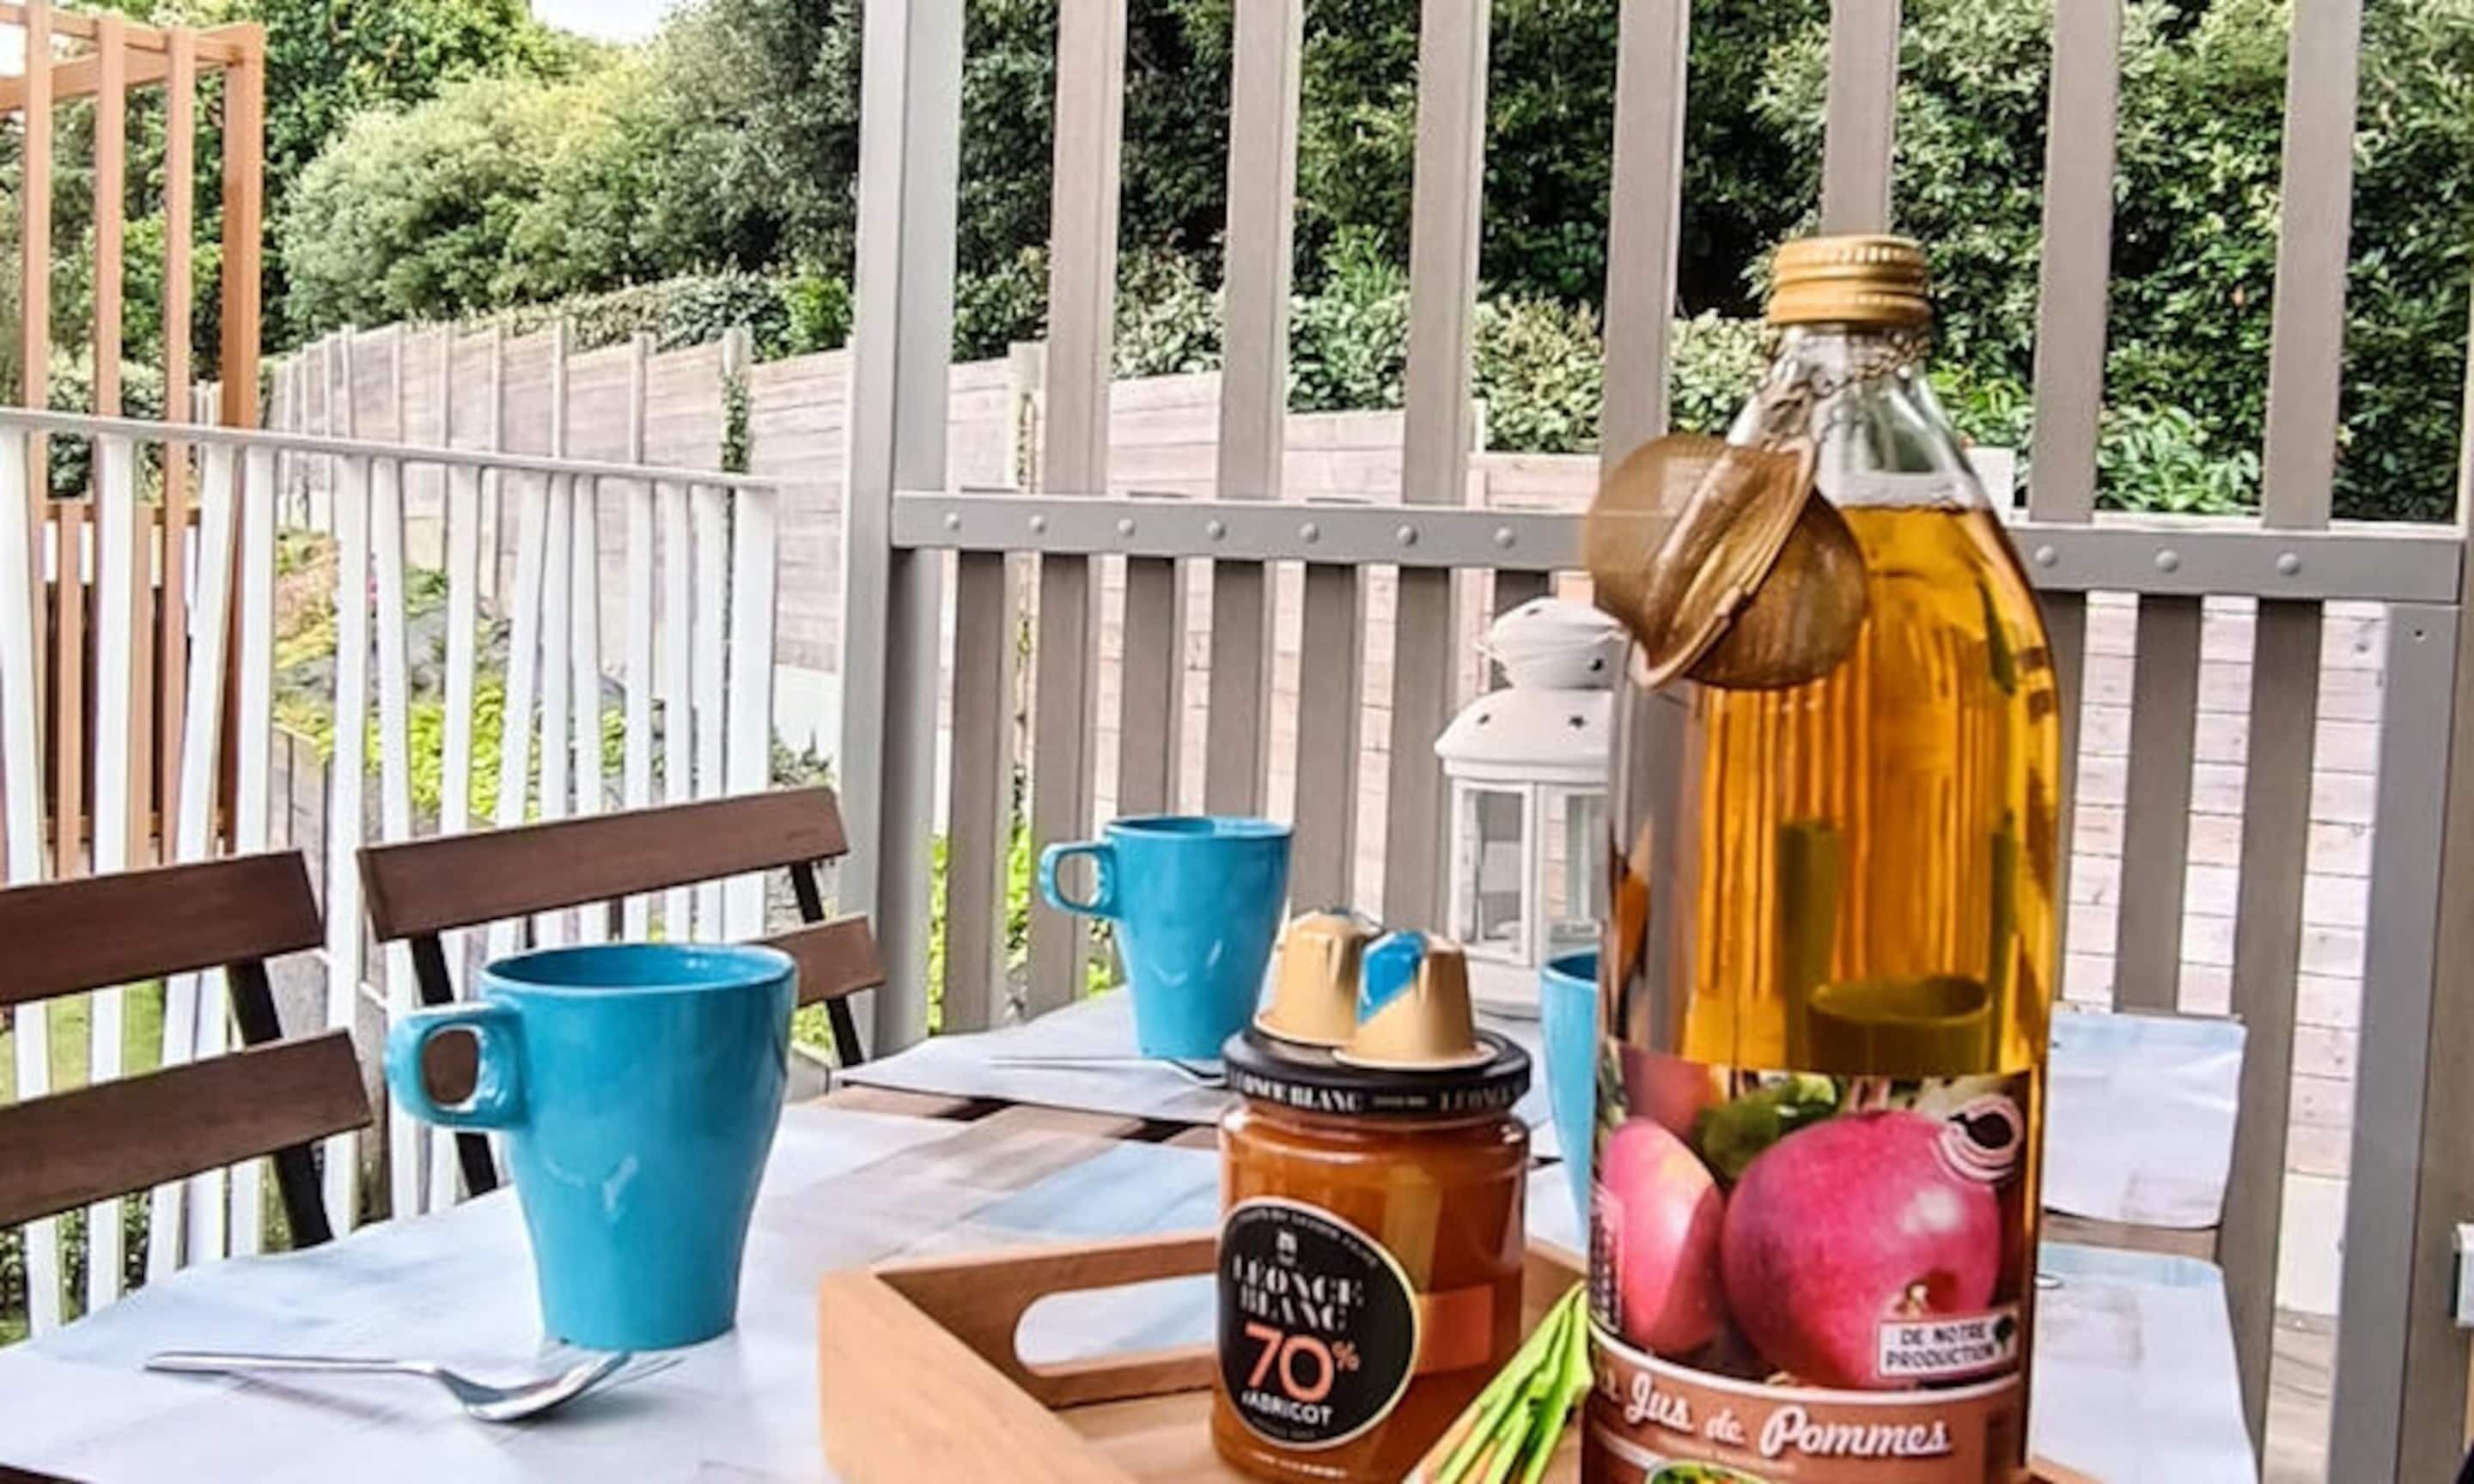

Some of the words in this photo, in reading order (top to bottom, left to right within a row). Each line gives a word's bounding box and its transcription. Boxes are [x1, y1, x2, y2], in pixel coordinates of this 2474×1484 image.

[1289, 1085, 1360, 1112] BLANC
[1241, 1284, 1349, 1332] BLANC
[1900, 1329, 1923, 1346] DE
[1933, 1323, 1986, 1343] NOTRE
[1885, 1343, 1995, 1368] PRODUCTION
[1624, 1371, 1693, 1434] Jus
[1704, 1408, 1746, 1444] de
[1758, 1404, 1952, 1457] Pommes
